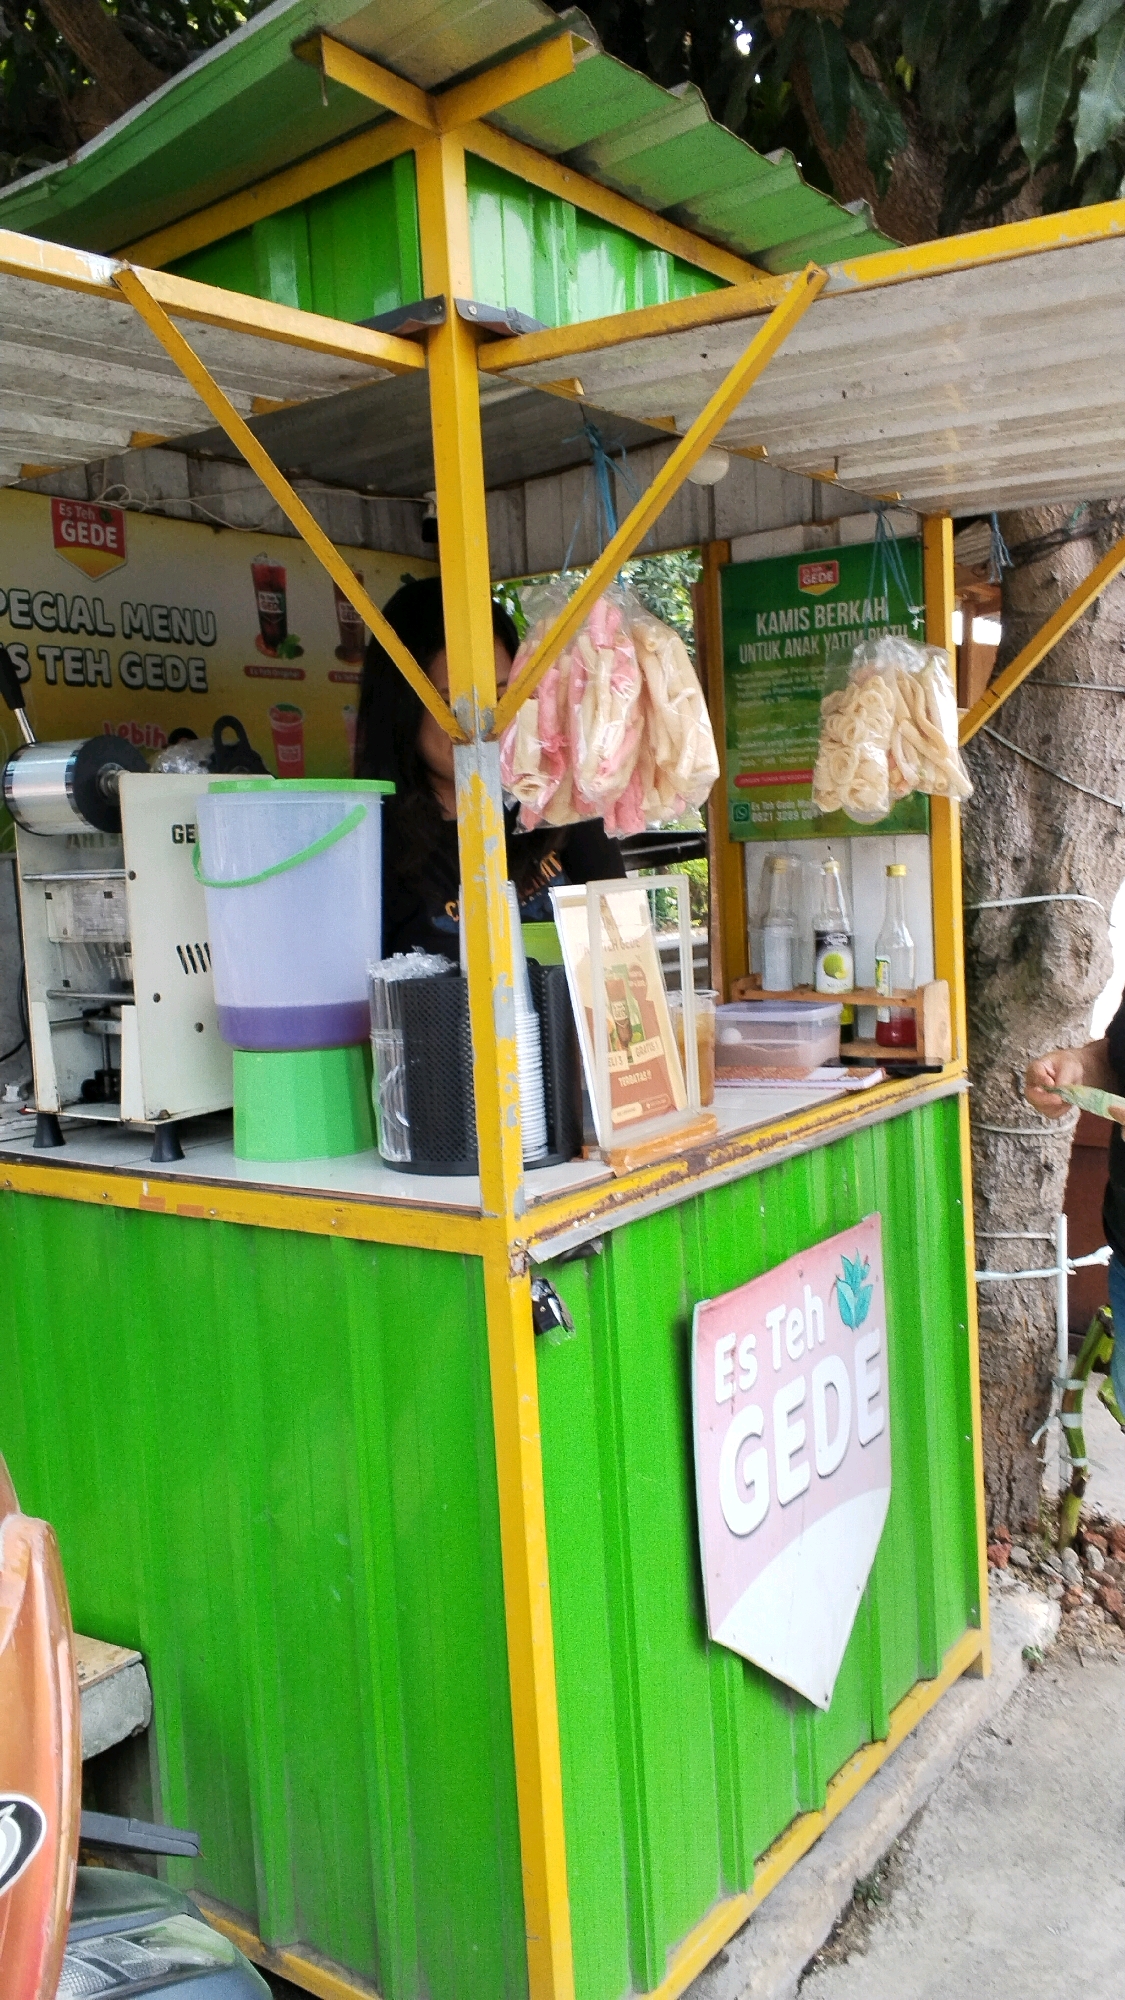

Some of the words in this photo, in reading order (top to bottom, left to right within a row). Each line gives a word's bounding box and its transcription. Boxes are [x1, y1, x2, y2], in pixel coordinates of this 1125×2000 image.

[59, 503, 73, 517] Es
[74, 505, 95, 520] Teh
[61, 519, 118, 549] GEDE
[121, 601, 216, 646] MENU
[756, 607, 810, 636] KAMIS
[814, 596, 888, 629] BERKAH
[37, 646, 112, 687] TEH
[119, 651, 208, 693] GEDE
[739, 640, 781, 664] UNTUK
[784, 634, 820, 658] ANAK
[714, 1332, 758, 1405] Es
[766, 1284, 825, 1372] Teh
[719, 1328, 886, 1539] GEDE
